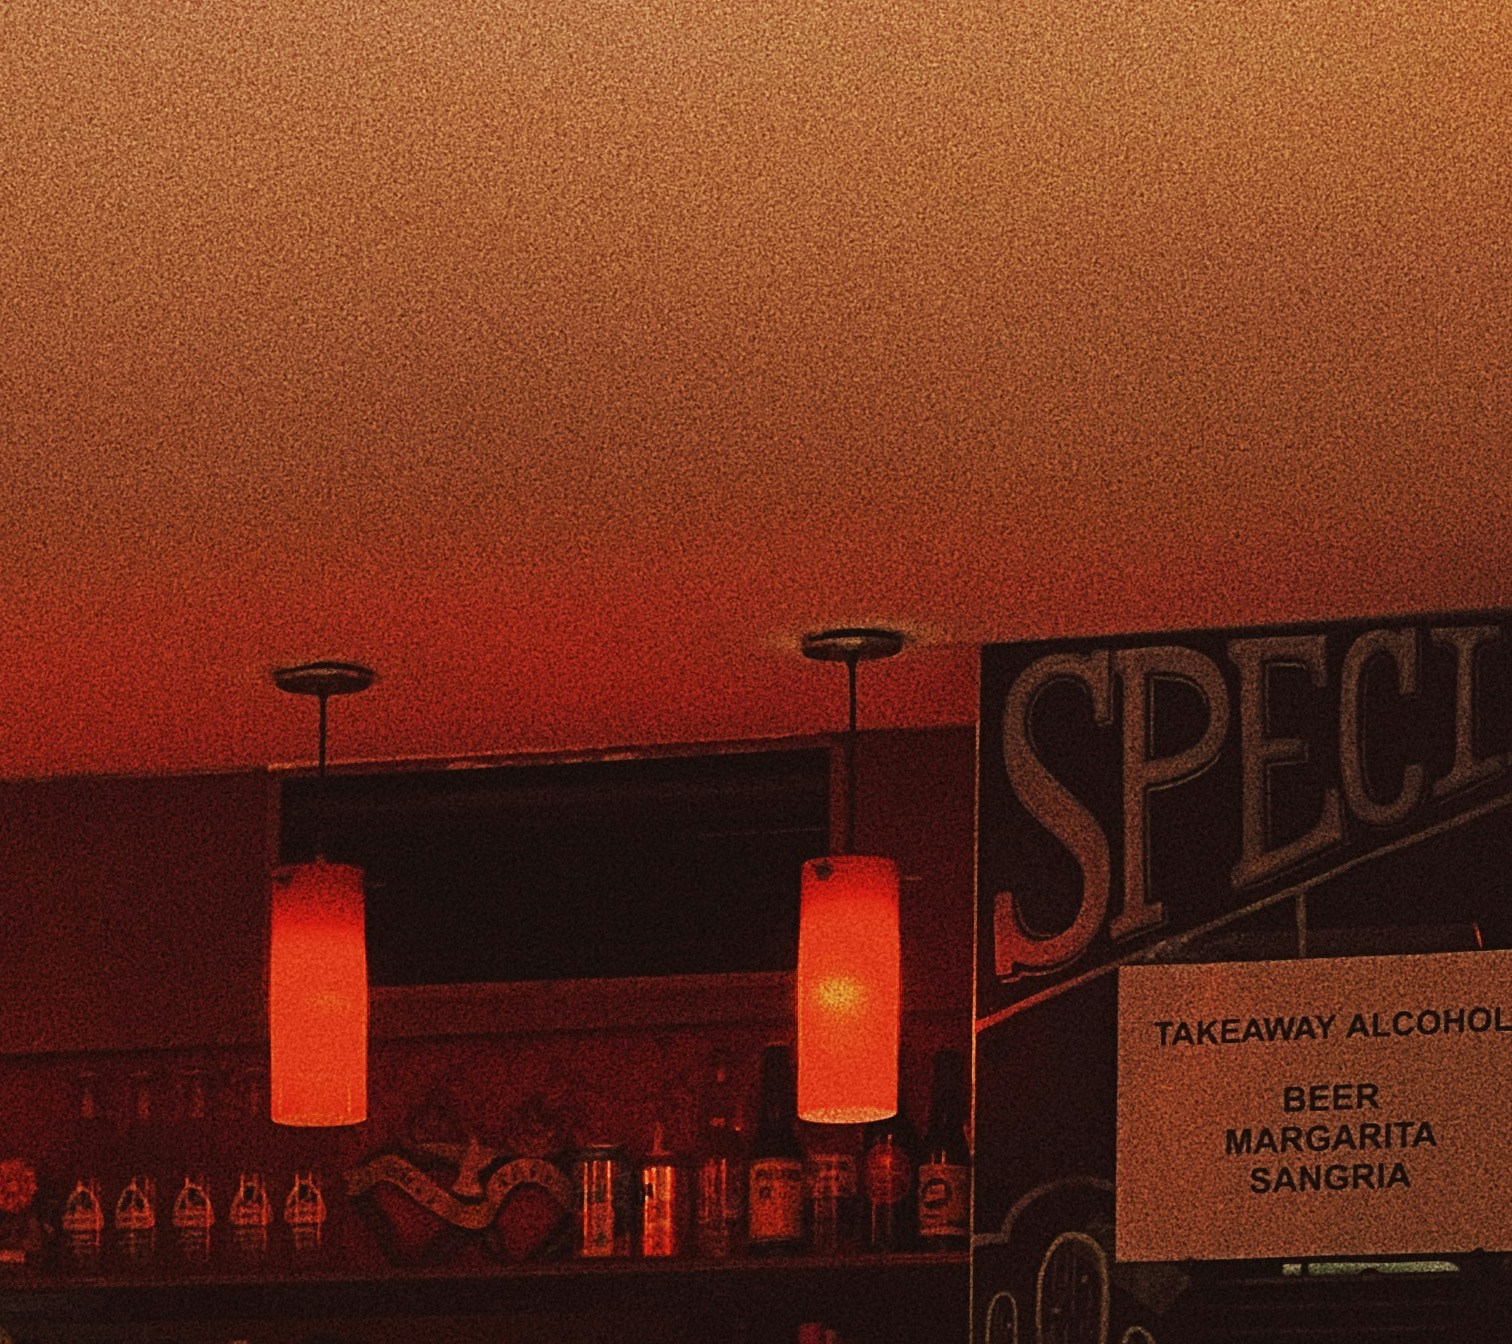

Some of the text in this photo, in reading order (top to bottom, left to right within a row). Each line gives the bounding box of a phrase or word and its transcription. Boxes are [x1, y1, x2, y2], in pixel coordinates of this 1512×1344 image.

[1154, 1006, 1512, 1046] TAKEAWAY ALCOHOL
[1283, 1083, 1380, 1113] BEER
[1225, 1121, 1437, 1154] MARGARITA
[1250, 1162, 1411, 1194] SANGRIA
